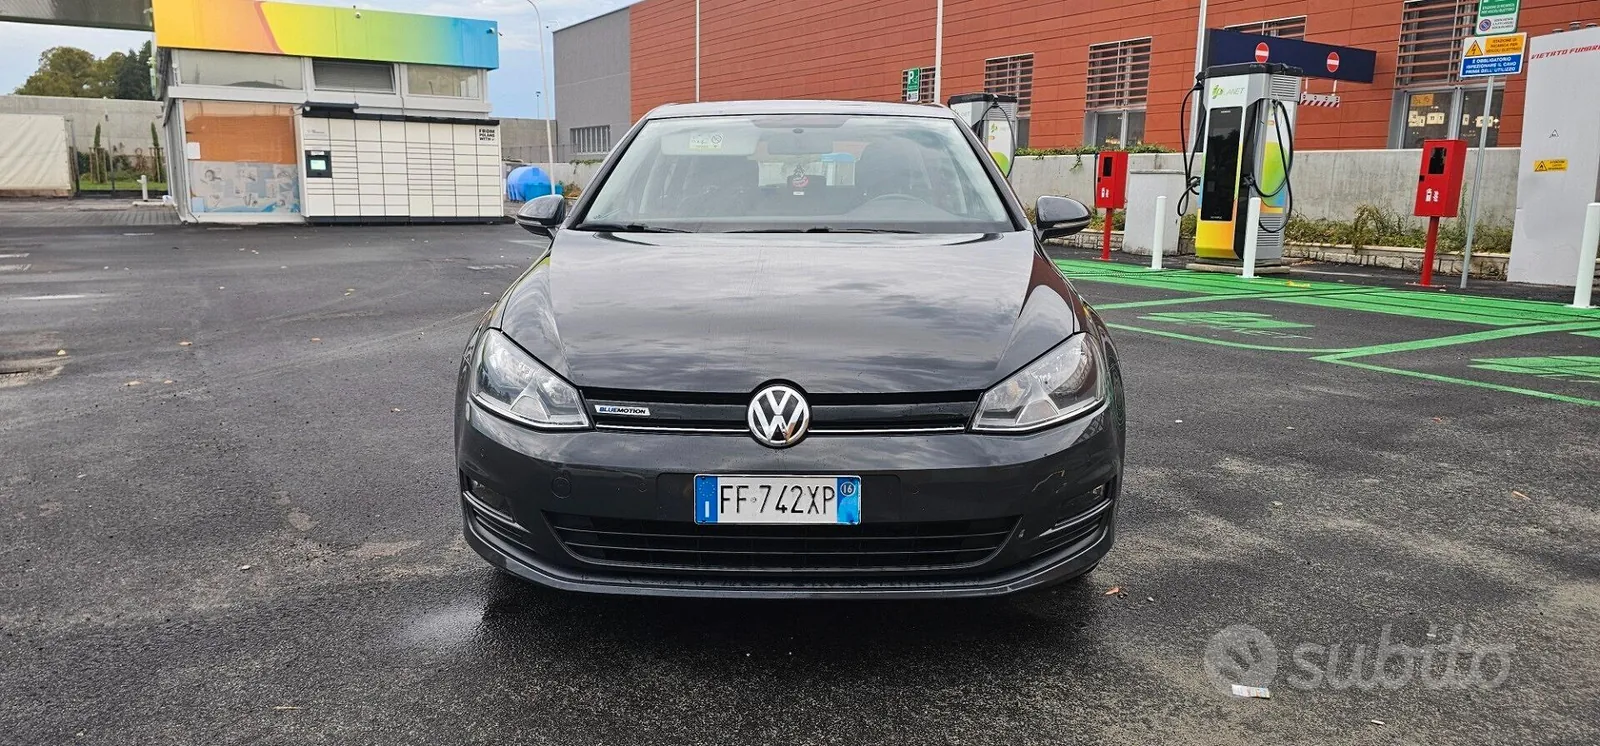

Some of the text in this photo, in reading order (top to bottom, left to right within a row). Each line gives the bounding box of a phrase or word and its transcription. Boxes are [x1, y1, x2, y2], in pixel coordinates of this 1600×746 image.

[1531, 49, 1567, 59] VIETATO
[908, 71, 914, 85] P
[842, 484, 853, 494] 16
